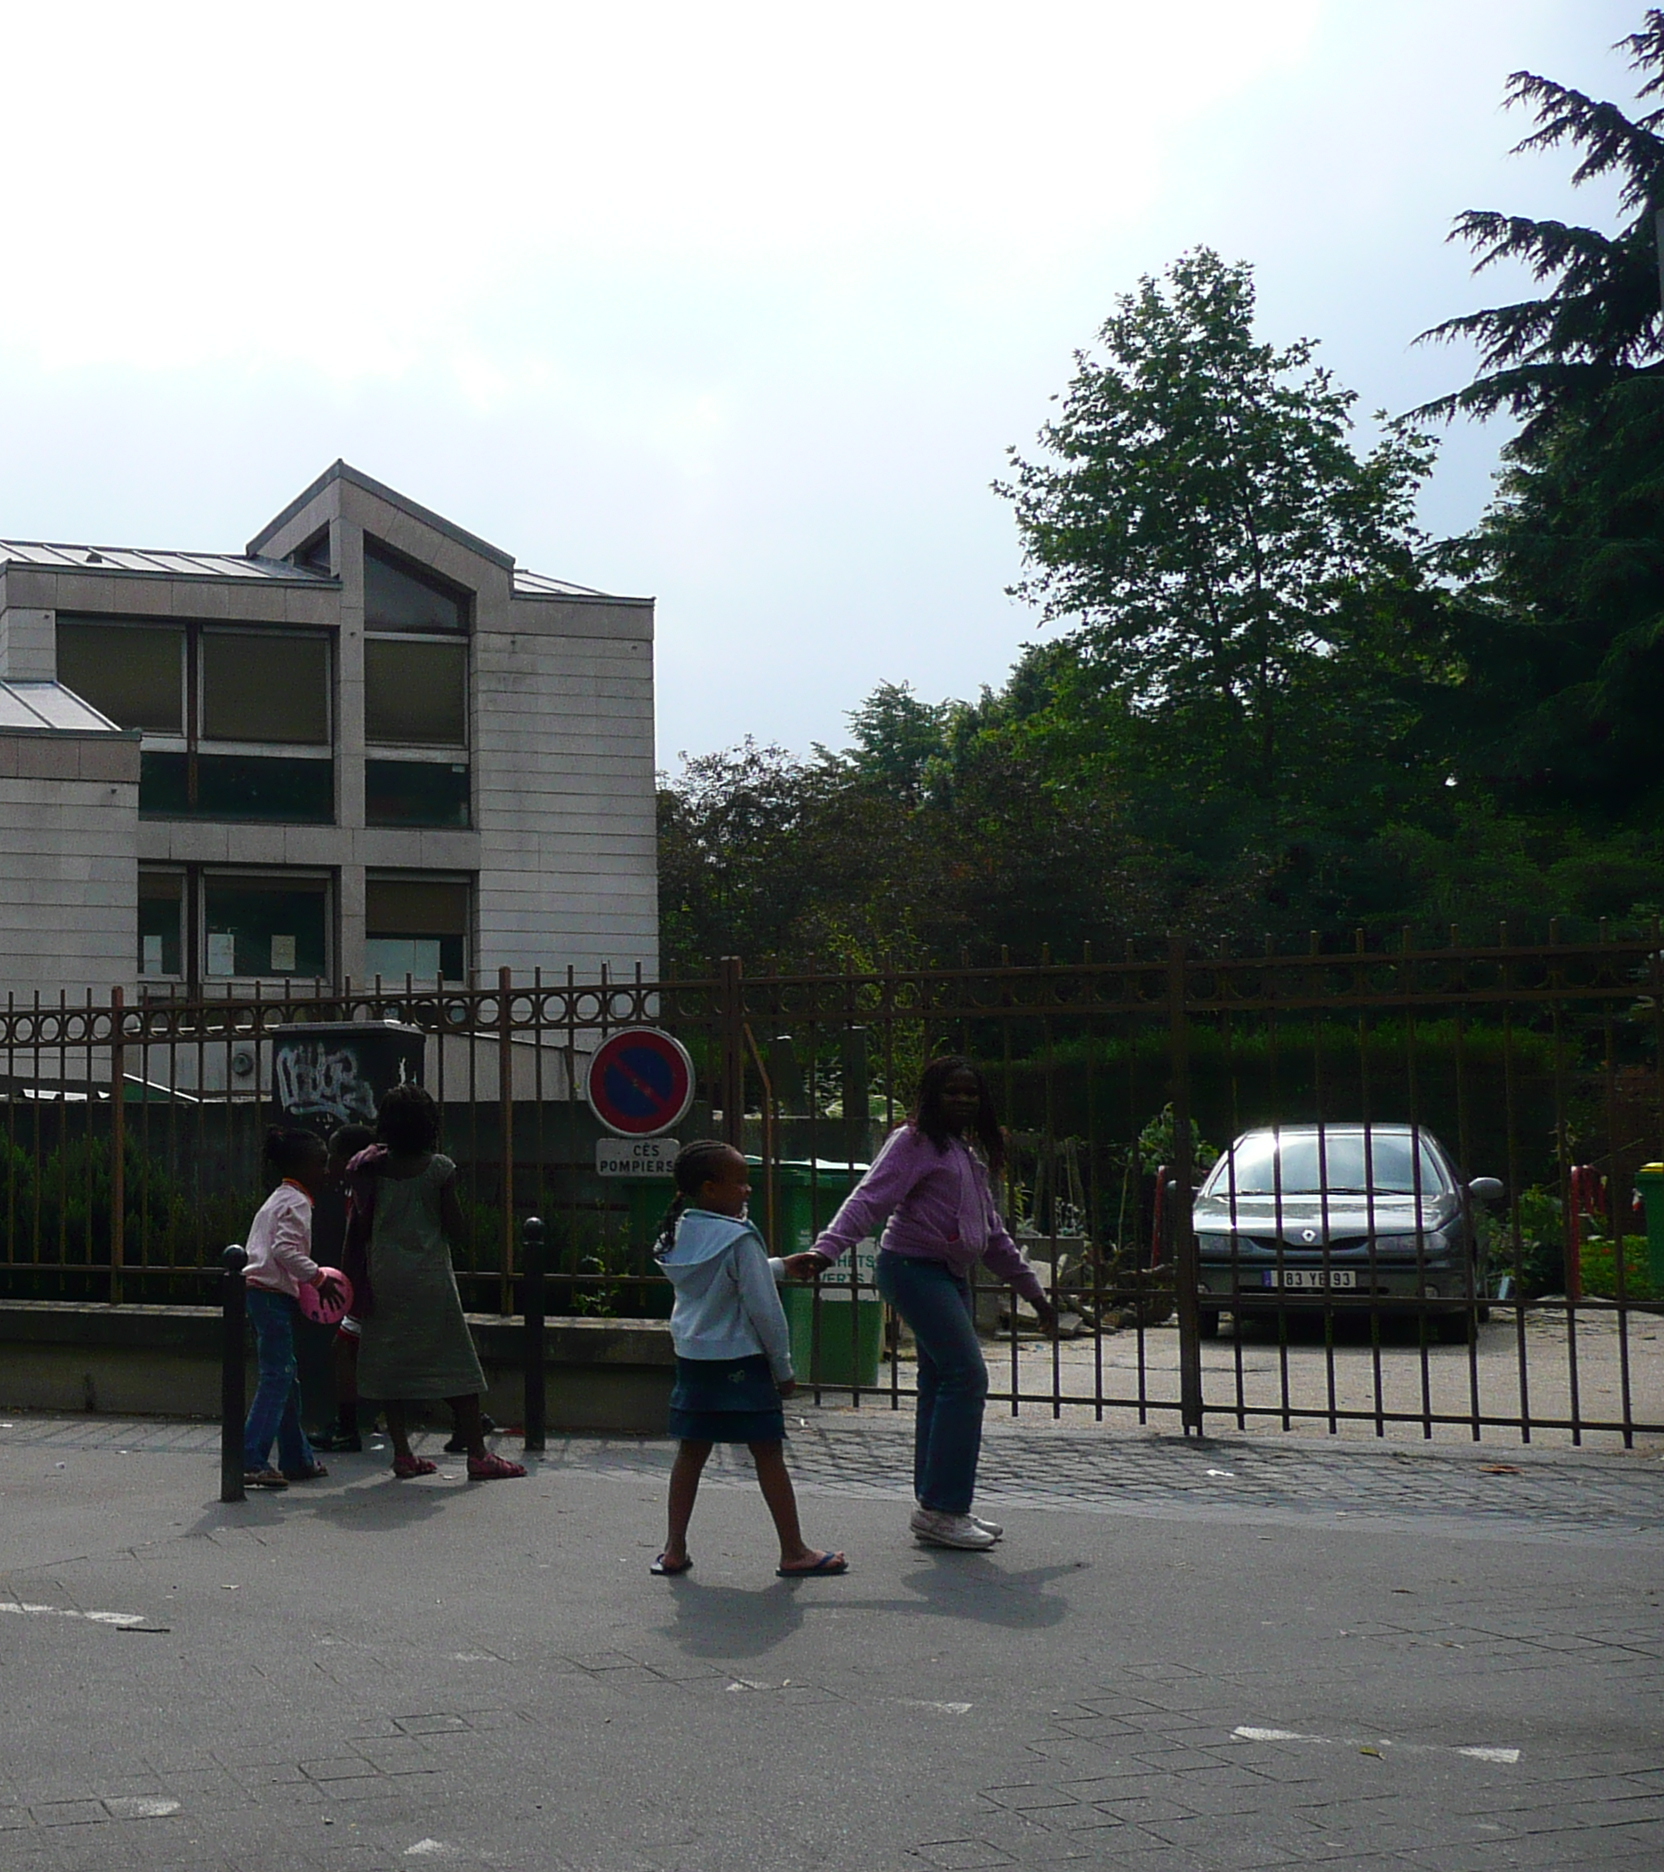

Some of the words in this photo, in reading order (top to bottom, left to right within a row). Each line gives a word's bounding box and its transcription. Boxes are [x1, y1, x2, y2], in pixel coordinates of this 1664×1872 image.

[600, 1161, 674, 1172] POMPIERS
[838, 1254, 874, 1267] HETS
[1285, 1272, 1303, 1286] 83
[1333, 1272, 1351, 1286] 93
